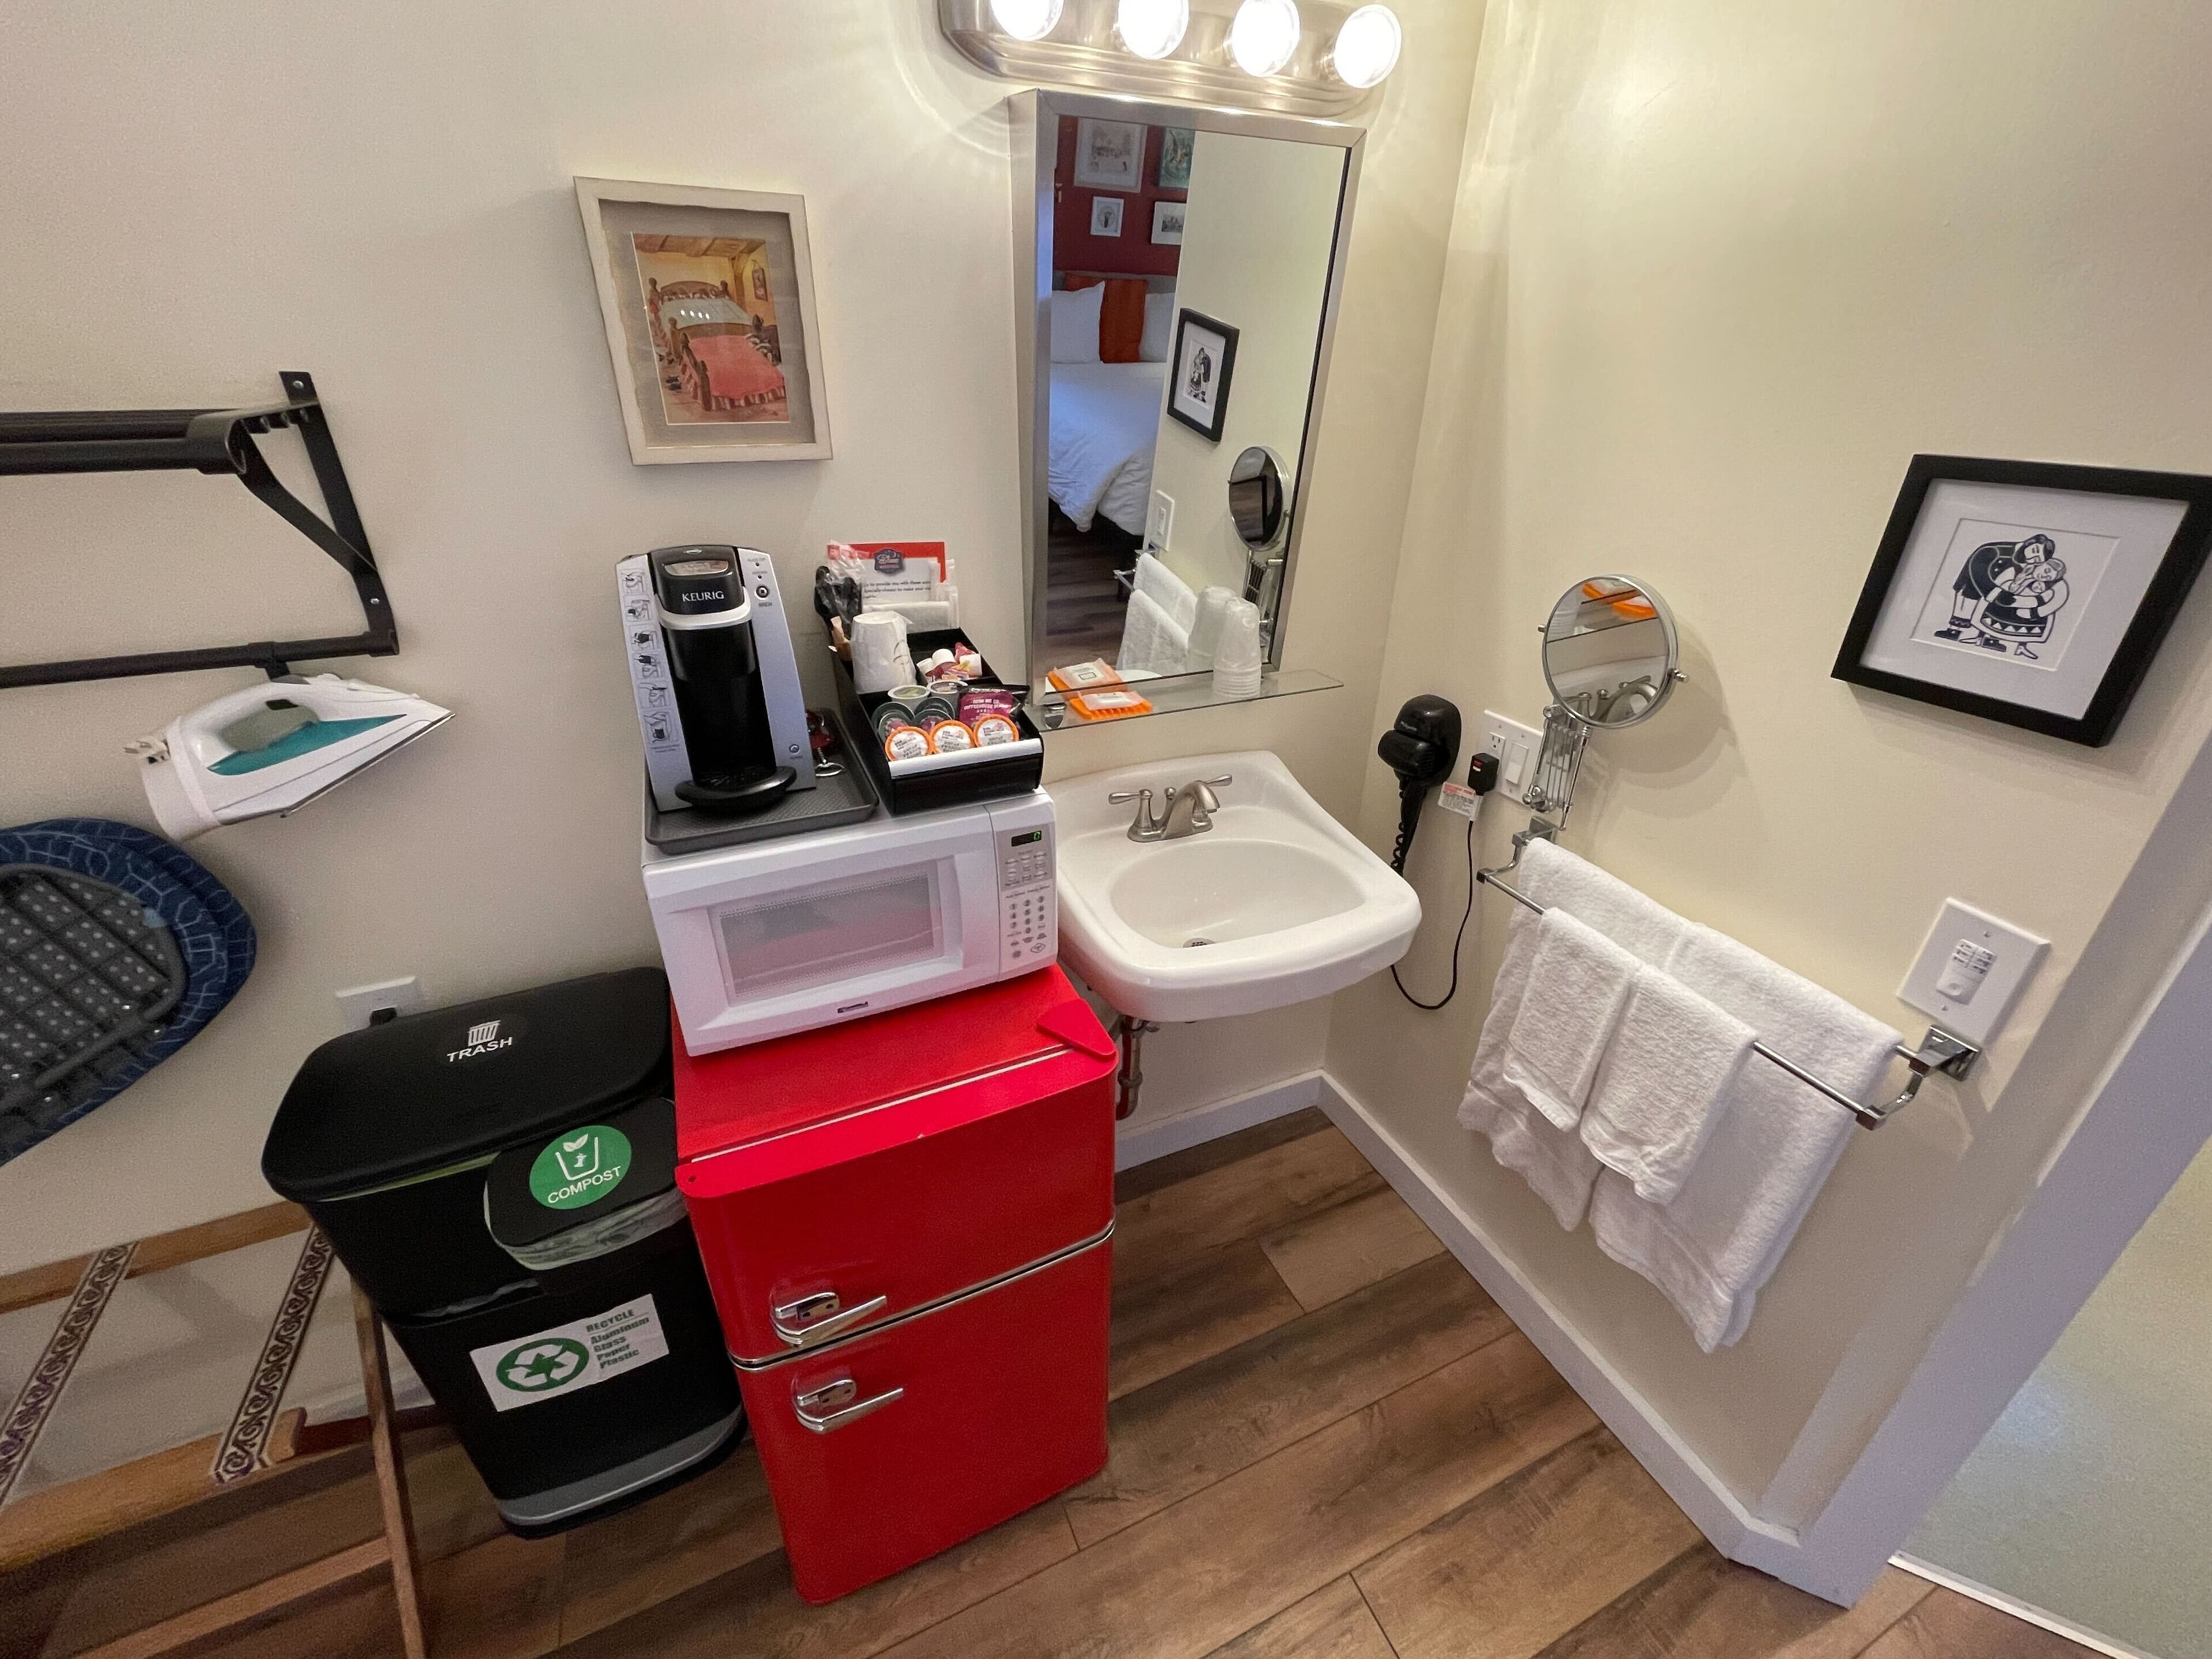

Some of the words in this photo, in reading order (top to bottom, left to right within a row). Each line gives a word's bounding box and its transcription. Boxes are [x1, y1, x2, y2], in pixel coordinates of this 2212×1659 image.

[682, 590, 724, 602] KEURIG
[447, 1037, 512, 1062] TRASH
[548, 1166, 621, 1203] COMPOST
[586, 1309, 634, 1332] RECYCLE
[590, 1317, 649, 1344] Aluminum
[593, 1336, 627, 1353] Glass
[597, 1344, 630, 1361] Paper
[600, 1350, 640, 1369] Plastic
